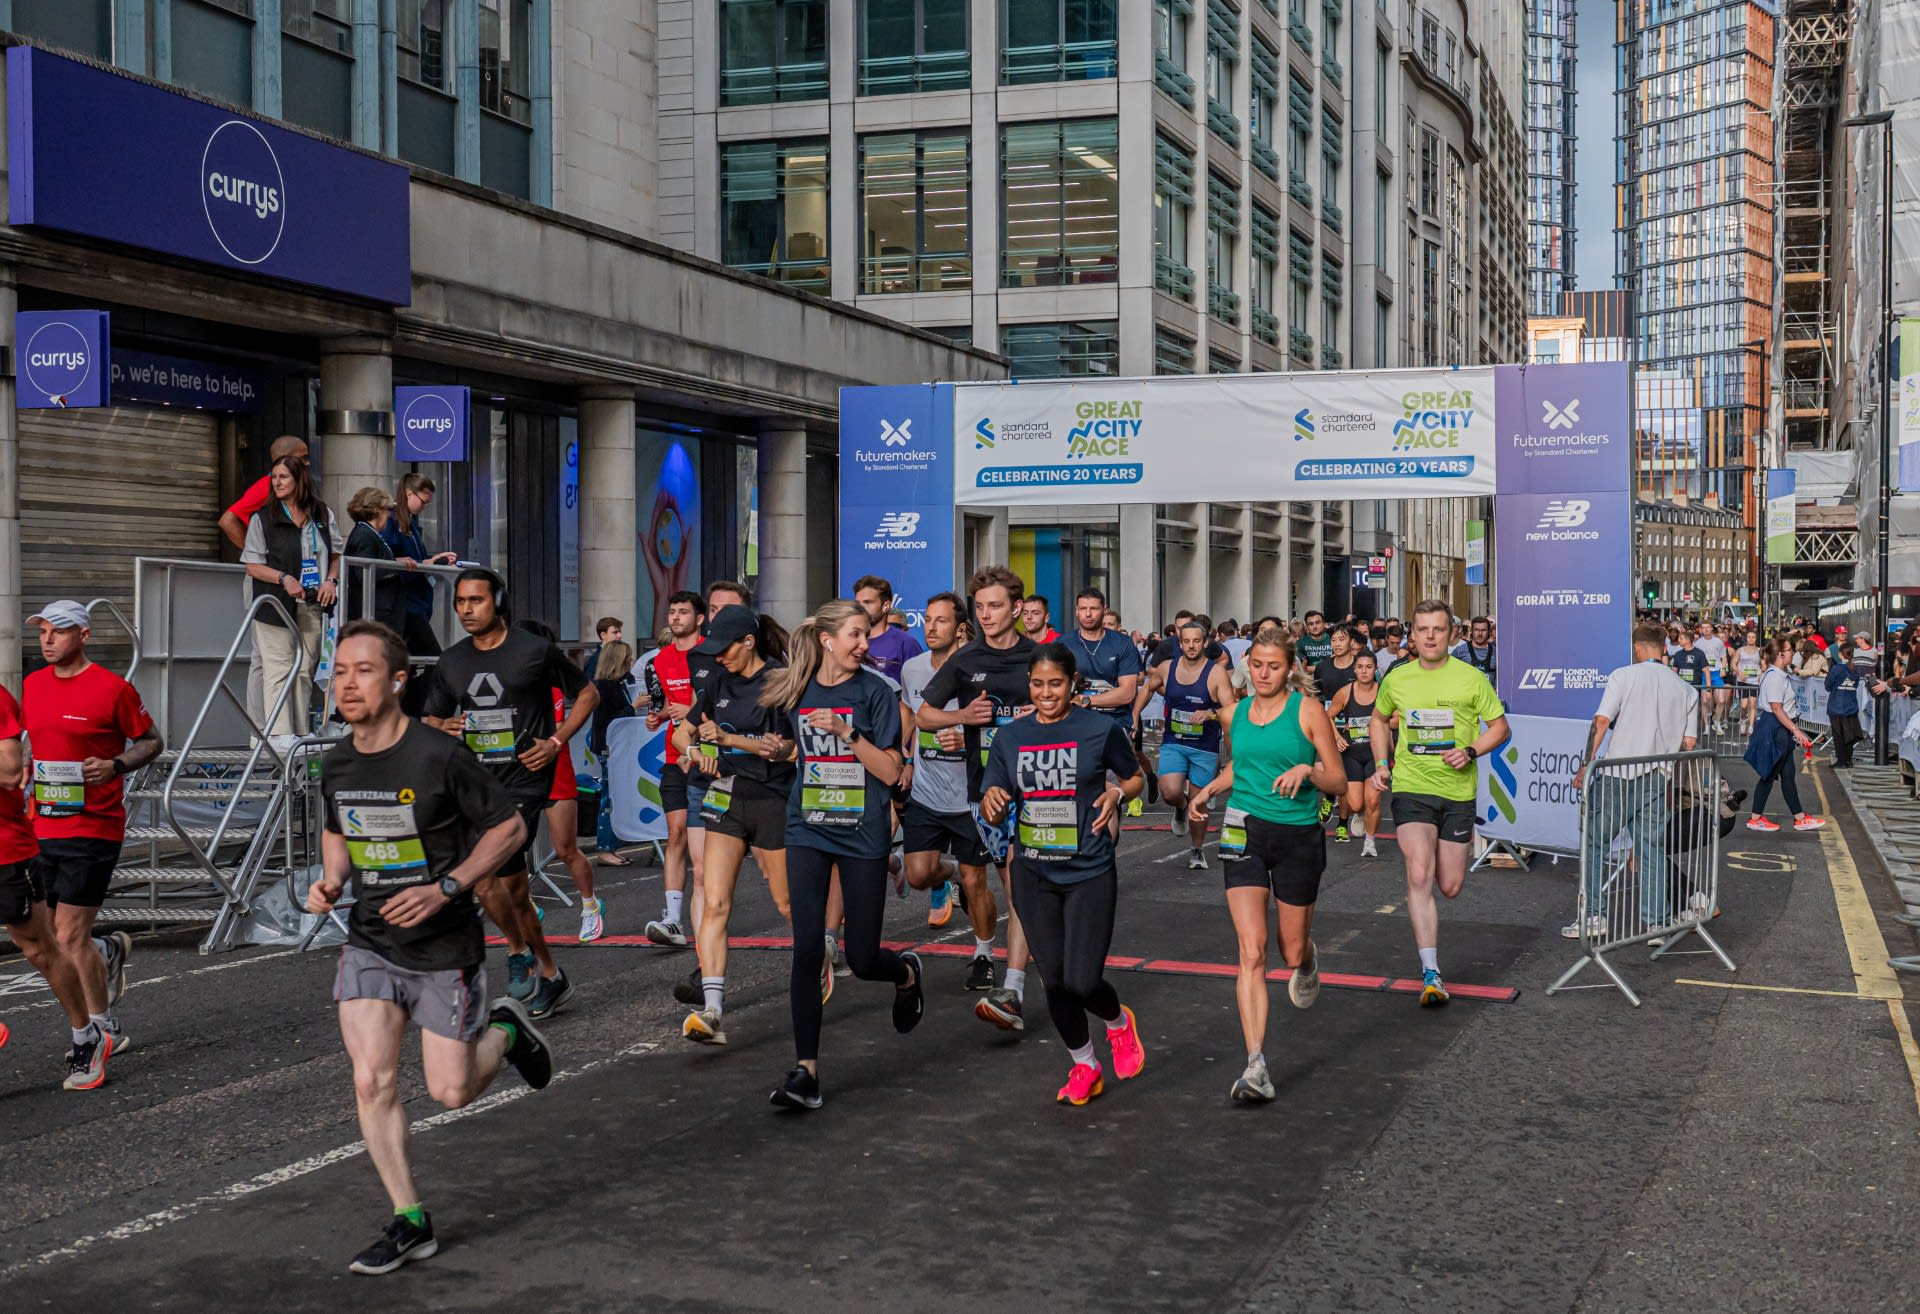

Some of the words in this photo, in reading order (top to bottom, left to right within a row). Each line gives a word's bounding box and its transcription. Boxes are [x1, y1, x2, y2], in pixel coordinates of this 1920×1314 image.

[209, 172, 279, 219] currys
[31, 351, 85, 371] currys
[129, 364, 168, 386] we're
[171, 368, 202, 390] here
[205, 374, 220, 394] to
[222, 376, 255, 401] help.
[1402, 390, 1474, 410] GREAT
[1075, 400, 1143, 419] GREAT
[1321, 412, 1373, 423] standard
[1422, 410, 1474, 429] CITY
[407, 418, 452, 433] currys
[1001, 421, 1049, 433] standard
[1094, 419, 1143, 438] CITY
[1321, 422, 1376, 433] chartered
[1001, 430, 1052, 441] chartered
[1513, 433, 1610, 448] futuremakers
[855, 450, 937, 462] futuremakers
[1524, 449, 1533, 458] by
[1534, 448, 1565, 456] Standard
[1566, 447, 1599, 455] Chartered
[1300, 462, 1397, 476] CELEBRATING
[1400, 463, 1417, 474] 20
[1420, 460, 1468, 473] YEARS
[981, 470, 1071, 483] CELEBRATING
[1074, 468, 1090, 481] 20
[1092, 468, 1137, 480] YEARS
[1526, 532, 1549, 541] new
[1551, 530, 1600, 541] balance
[864, 542, 885, 550] new
[886, 540, 927, 550] balance
[1516, 595, 1554, 606] GORAM
[1558, 595, 1580, 606] IPA
[1583, 593, 1611, 605] ZERO
[1563, 668, 1599, 676] LONDON
[1563, 681, 1594, 689] EVENTS
[1417, 729, 1443, 740] 1349
[1017, 747, 1078, 773] RUN
[1529, 747, 1583, 775] stand
[1016, 768, 1077, 793] LME
[43, 787, 70, 798] 2016
[819, 790, 846, 803] 220
[1033, 828, 1057, 841] 218
[365, 844, 400, 860] 468
